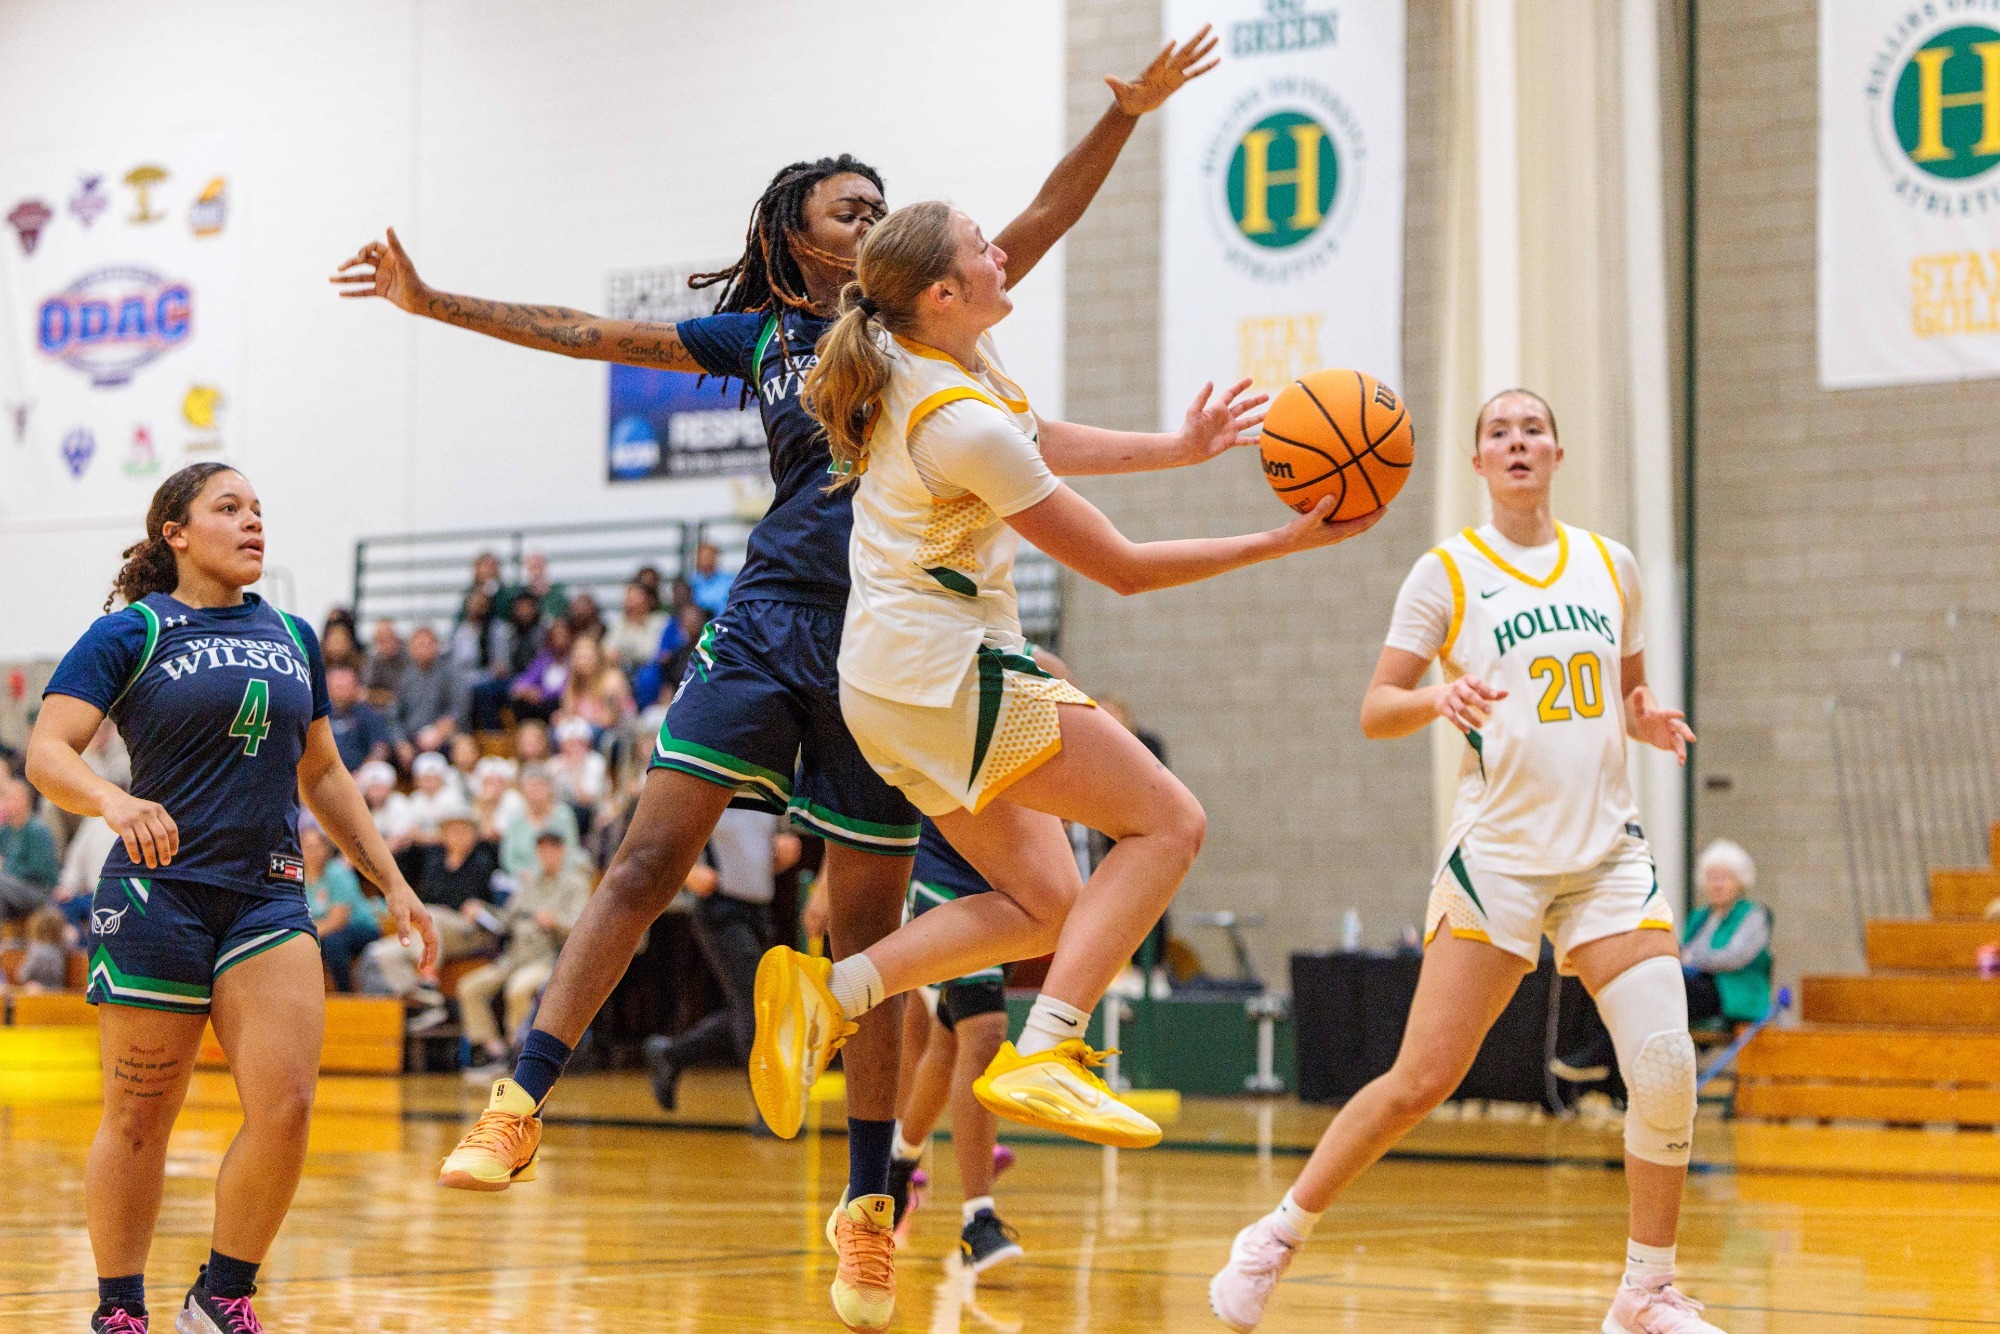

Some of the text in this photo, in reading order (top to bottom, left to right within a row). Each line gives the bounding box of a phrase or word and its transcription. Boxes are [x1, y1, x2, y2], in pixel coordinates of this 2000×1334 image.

[1241, 123, 1326, 234] H
[40, 285, 191, 352] ODAC
[185, 637, 292, 657] WARREN
[1494, 604, 1616, 657] HOLLINS
[160, 646, 312, 691] WILSON
[1529, 650, 1605, 723] 20
[228, 677, 272, 758] 4
